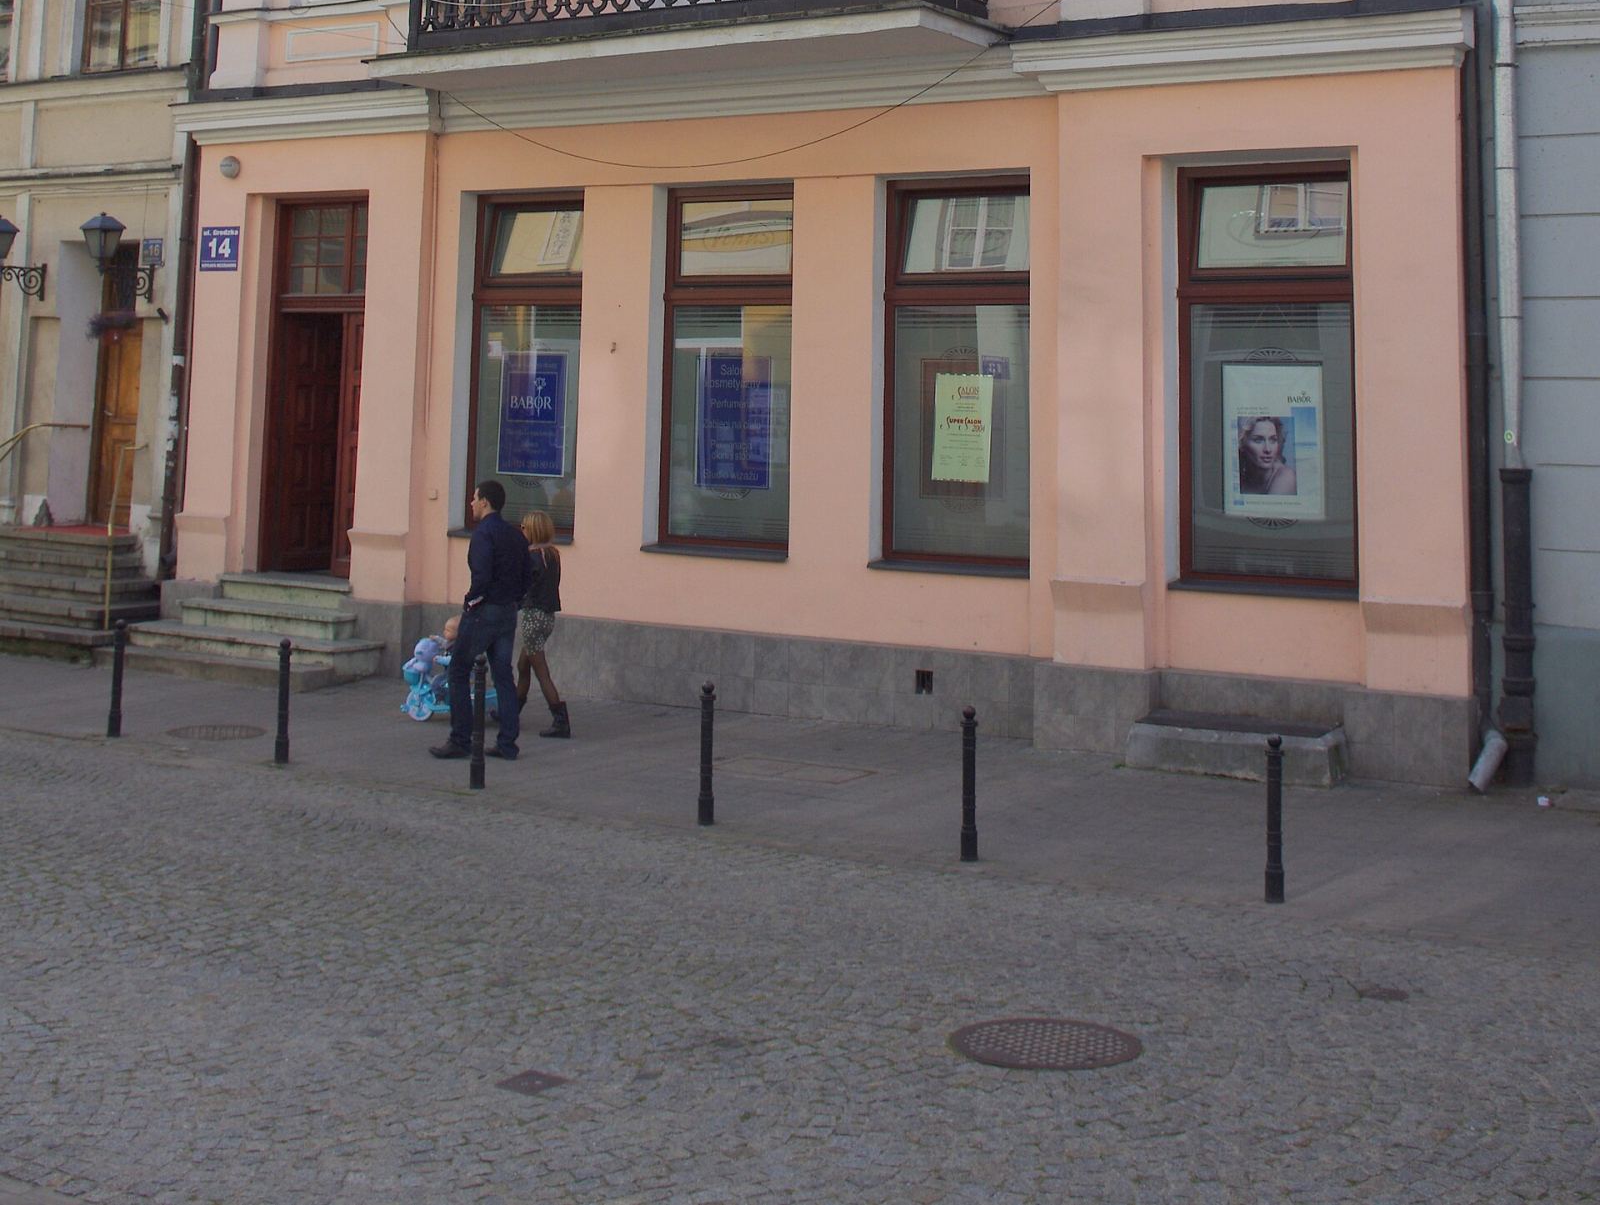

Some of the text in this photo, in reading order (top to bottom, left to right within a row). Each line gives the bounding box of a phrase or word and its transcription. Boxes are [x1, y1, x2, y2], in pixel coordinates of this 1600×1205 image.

[208, 237, 231, 258] 14
[720, 364, 746, 376] Salo
[510, 396, 552, 409] BABOR
